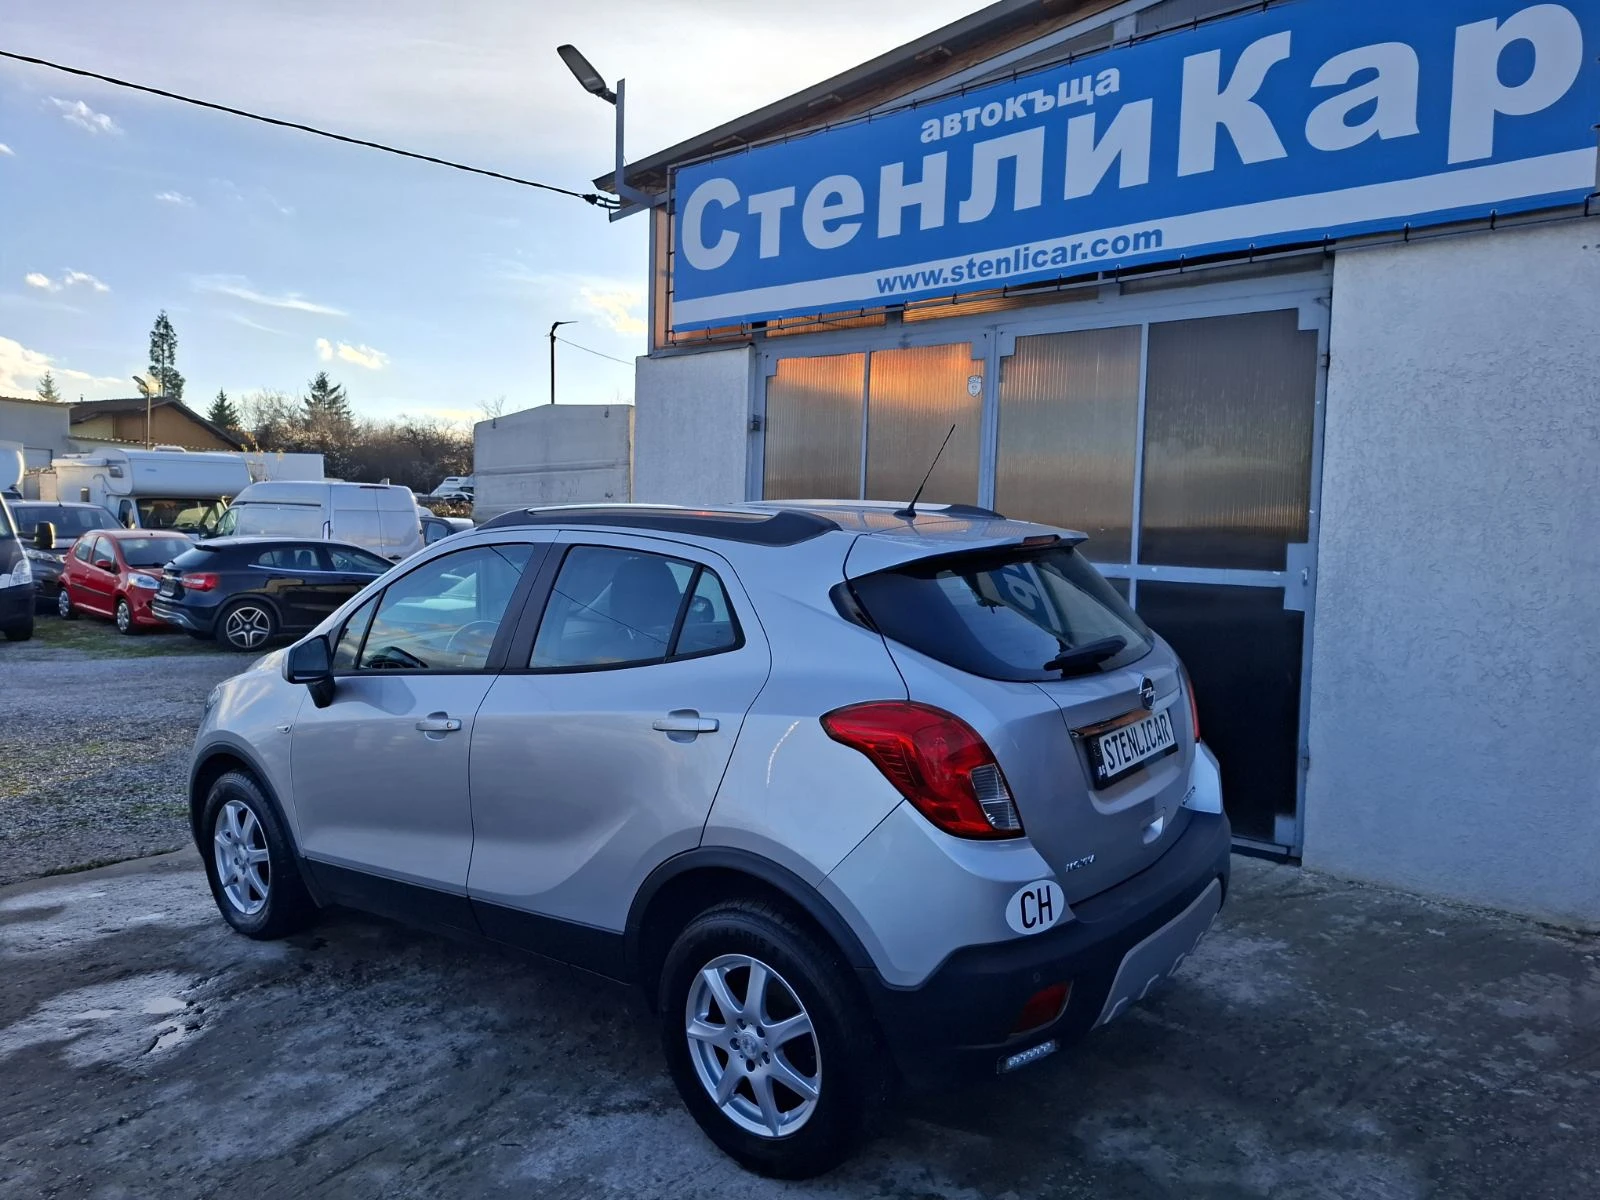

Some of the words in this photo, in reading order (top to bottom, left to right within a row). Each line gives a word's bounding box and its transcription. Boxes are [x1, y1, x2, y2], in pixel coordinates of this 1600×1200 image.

[681, 3, 1583, 271] СтенлиКар
[920, 67, 1120, 144] автокъща
[877, 228, 1162, 294] www.stenlicar.com
[1103, 714, 1171, 770] STENLICAR
[1020, 884, 1053, 929] CH
